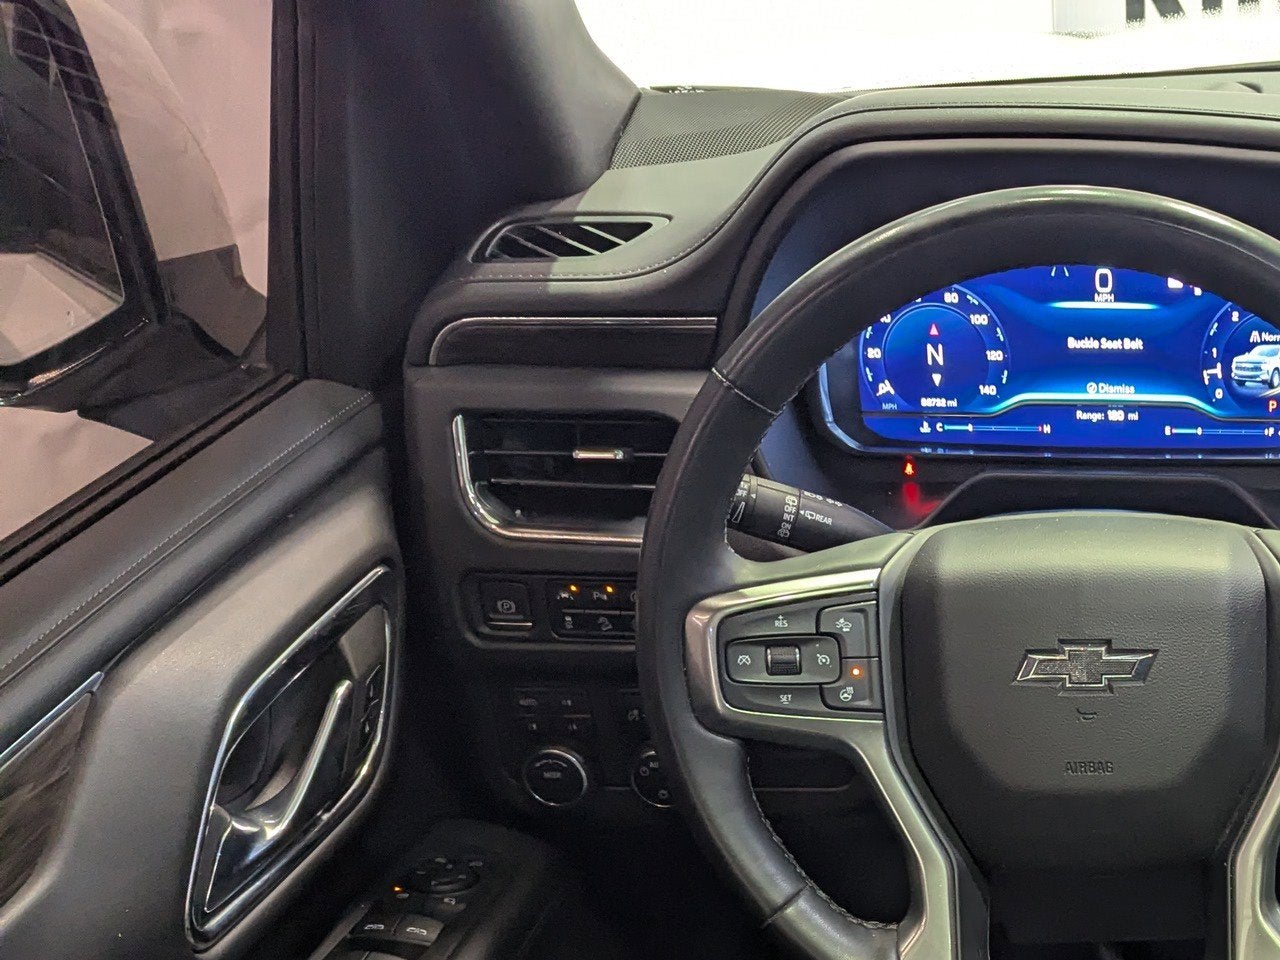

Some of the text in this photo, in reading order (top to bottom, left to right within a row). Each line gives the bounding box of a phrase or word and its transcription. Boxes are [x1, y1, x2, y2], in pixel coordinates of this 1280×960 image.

[1094, 293, 1115, 302] MPH
[969, 314, 989, 325] 100
[1067, 336, 1144, 350] Buckle Seat Belt
[926, 343, 944, 365] N
[986, 350, 1003, 361] 120
[979, 384, 997, 395] 140
[1098, 382, 1135, 394] Dismiss
[882, 402, 898, 410] MPH
[1269, 400, 1278, 412] P
[1075, 409, 1105, 422] Range:
[815, 513, 833, 526] REAR
[1065, 760, 1115, 773] AIRBAG
